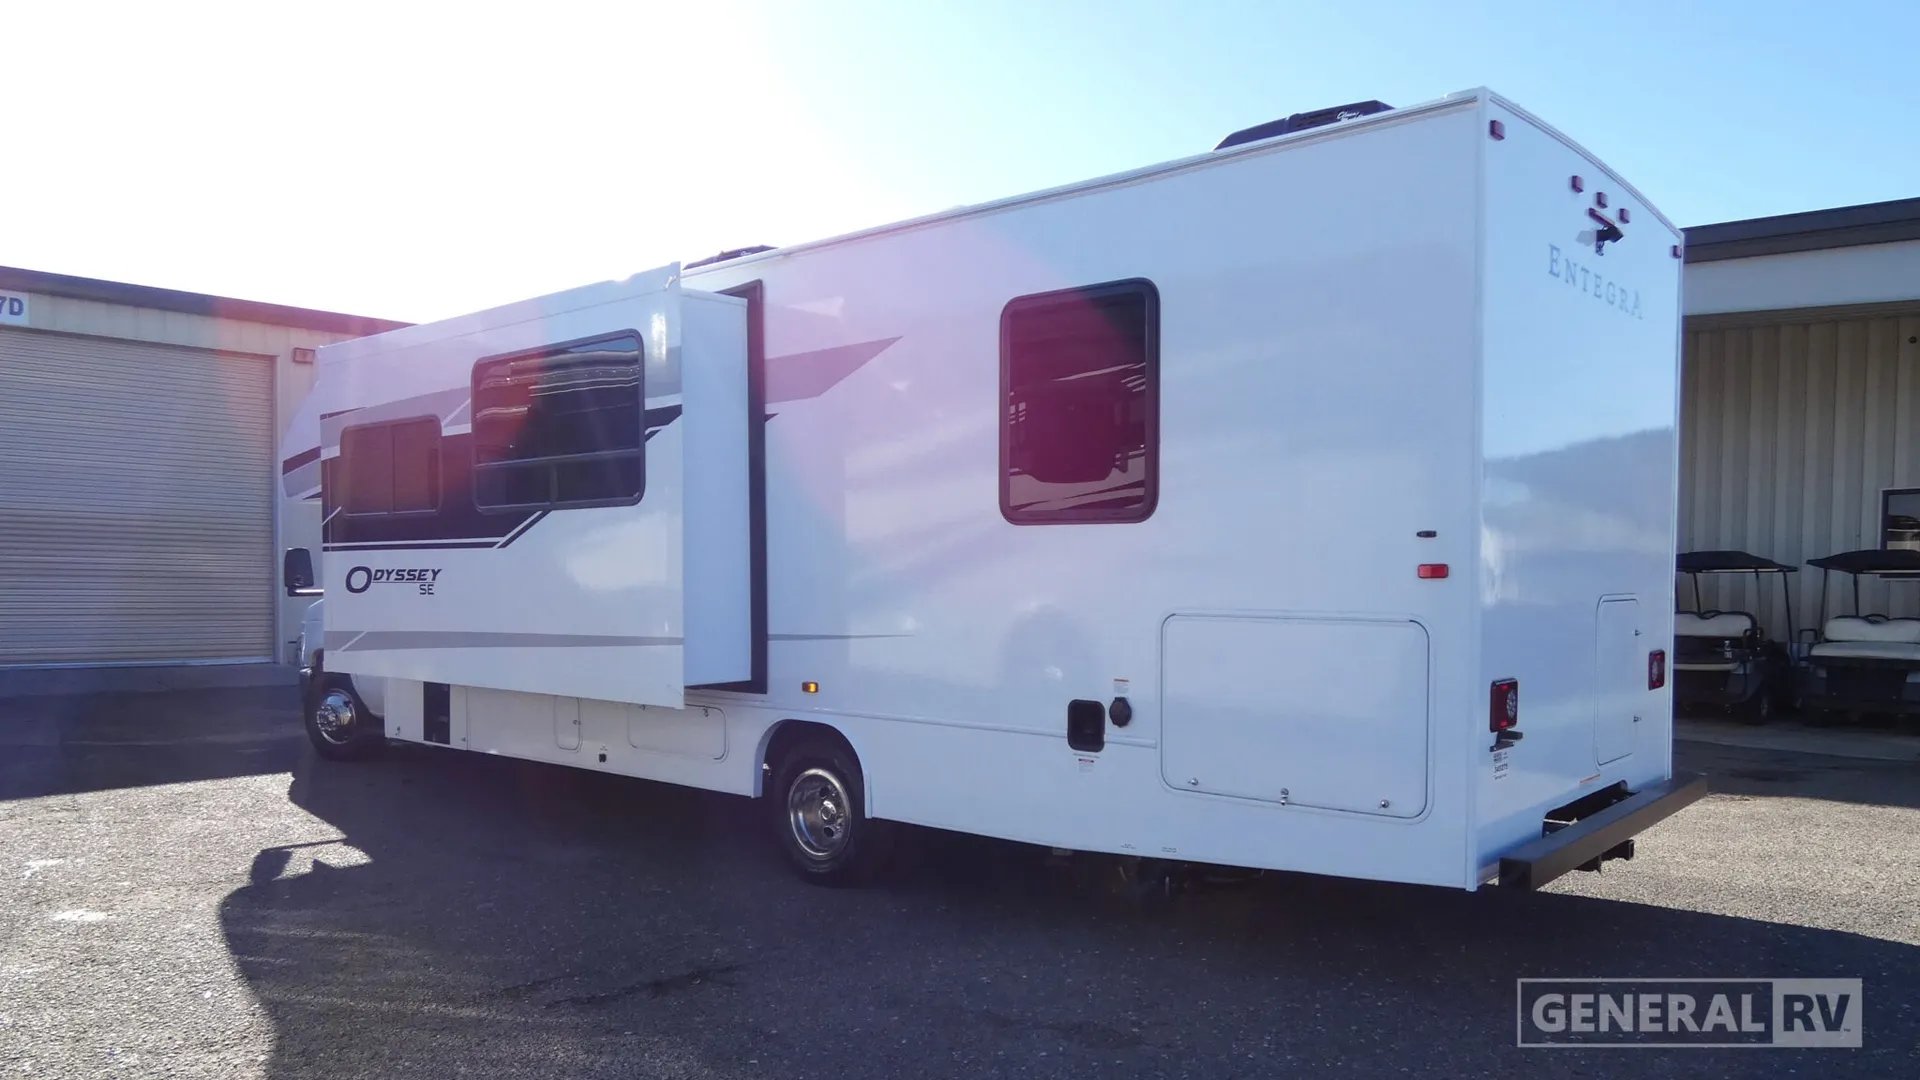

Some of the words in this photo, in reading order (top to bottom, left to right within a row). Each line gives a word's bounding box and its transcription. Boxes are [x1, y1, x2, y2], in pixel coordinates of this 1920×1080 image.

[1548, 243, 1643, 320] ENTEGRA
[345, 566, 442, 594] ODYSSEY
[419, 584, 435, 596] SE
